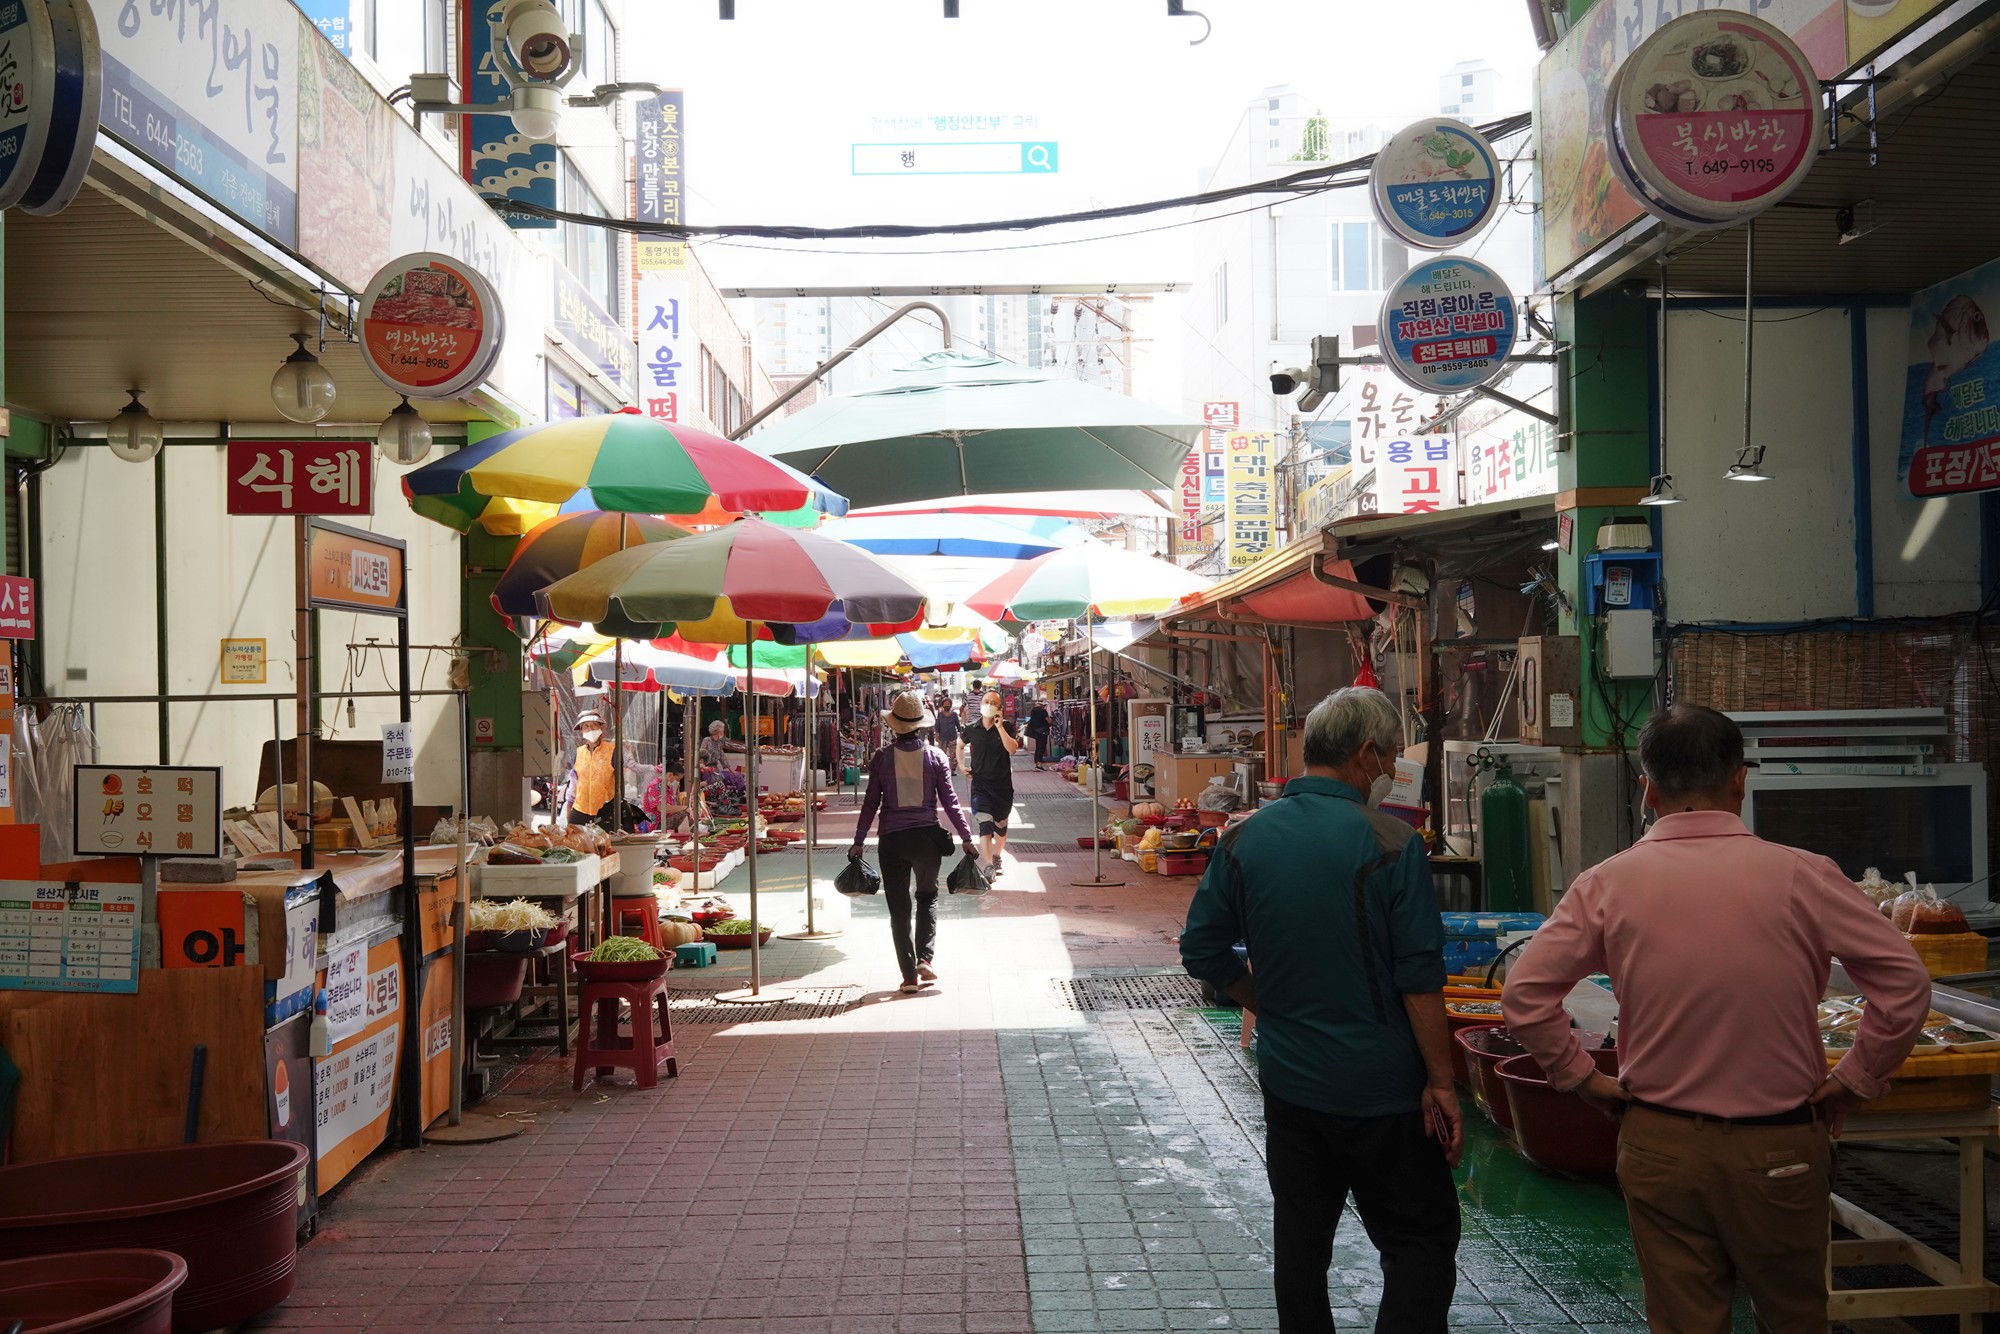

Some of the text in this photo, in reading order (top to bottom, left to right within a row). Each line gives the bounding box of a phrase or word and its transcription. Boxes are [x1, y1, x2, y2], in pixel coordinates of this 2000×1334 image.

[112, 88, 204, 176] TEL. 644-2563
[1672, 117, 1788, 156] 북신반찬
[901, 150, 915, 168] 행
[1686, 159, 1775, 176] T. 649-9195
[642, 121, 659, 218] 건강 만들기
[1429, 208, 1474, 221] 646-3015
[644, 245, 681, 257] 통영지점
[641, 257, 685, 267] 055.646.9486
[1432, 268, 1461, 280] 배달도
[1402, 291, 1495, 319] 직접 잡아 온
[1397, 310, 1505, 341] 자연산 막썰이
[386, 330, 459, 357] 연안반찬
[1419, 340, 1489, 361] 전국택배
[391, 353, 450, 370] T. 644-8985
[1422, 359, 1489, 375] 010-9559-8405
[1387, 438, 1451, 464] 용남
[238, 449, 360, 509] 식혜
[1233, 482, 1270, 515] 축산물
[1233, 520, 1272, 554] 판매장
[1231, 555, 1266, 565] 649-64
[354, 556, 388, 594] 씨앗호떡
[386, 729, 405, 743] 추석
[386, 747, 413, 761] 주문받
[37, 887, 65, 900] 원산지
[330, 960, 342, 980] 추석
[327, 978, 362, 1007] 주문받습니다
[318, 1109, 329, 1127] 오뎅
